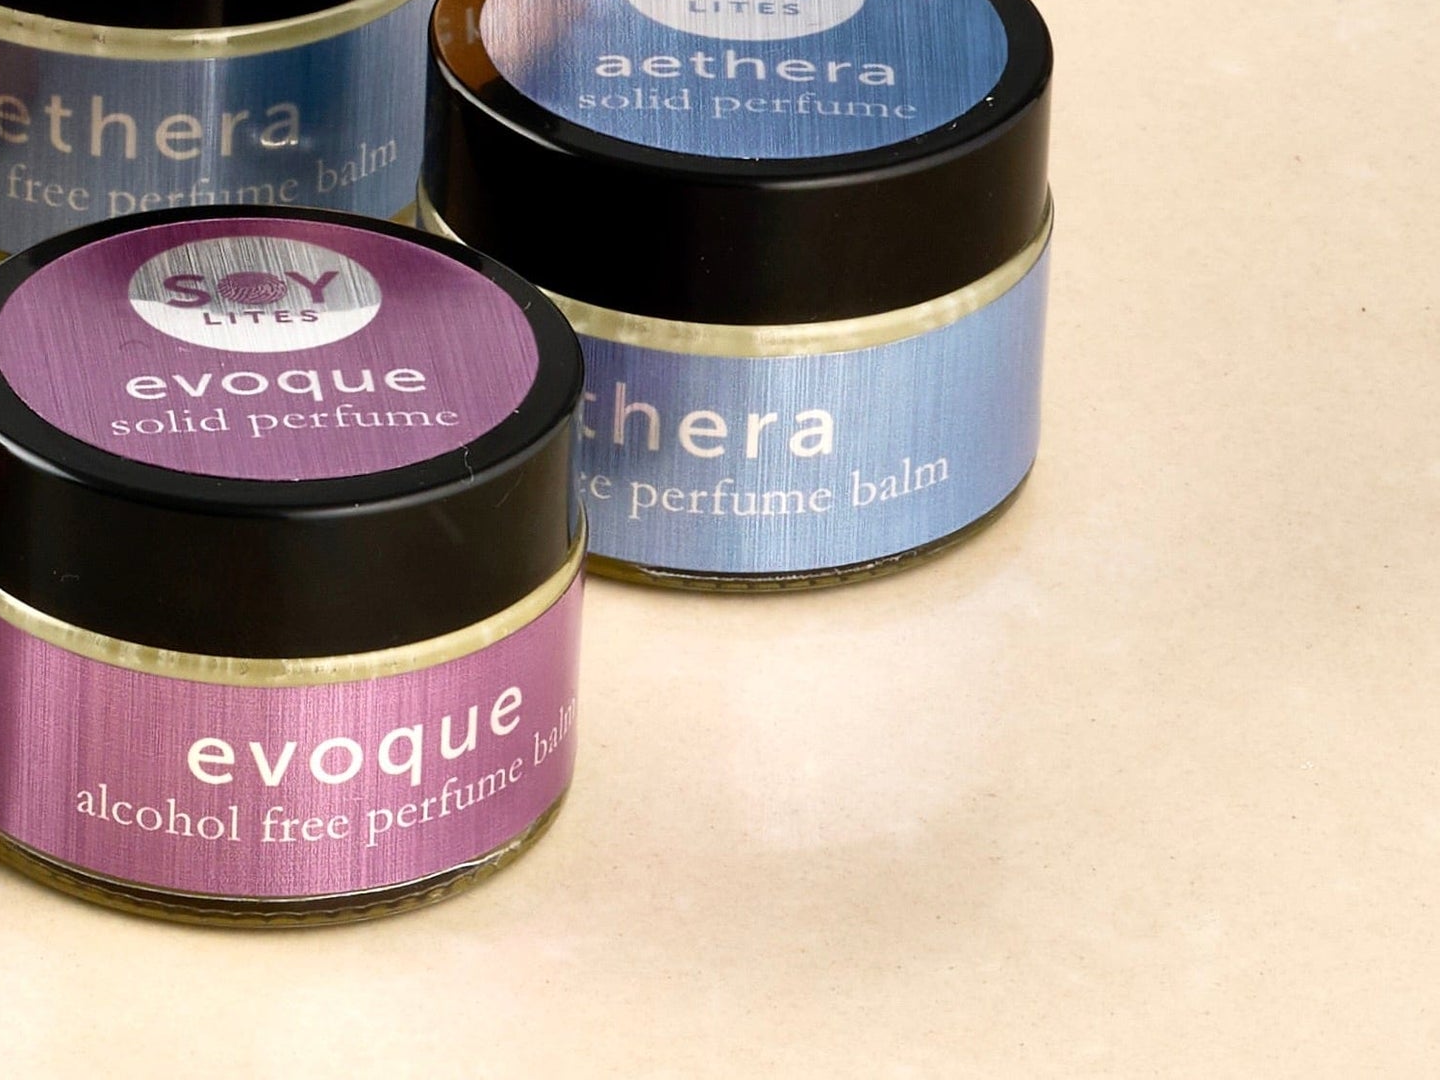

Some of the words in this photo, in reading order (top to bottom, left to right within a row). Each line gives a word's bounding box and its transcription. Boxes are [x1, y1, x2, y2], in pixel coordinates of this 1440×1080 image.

[688, 1, 801, 16] LITES
[595, 50, 897, 87] aethera
[579, 88, 691, 113] solid
[712, 91, 917, 121] perfume
[6, 166, 91, 213] free
[315, 136, 398, 194] balm
[162, 270, 339, 310] SOY
[204, 308, 320, 326] LITES
[124, 368, 427, 404] evoque
[111, 409, 228, 437] solid
[246, 403, 459, 438] perfume
[628, 474, 833, 520] perfume
[852, 453, 949, 507] balm
[186, 685, 522, 788] evoque
[76, 783, 239, 842] alcohol
[260, 804, 351, 843] free
[366, 756, 524, 849] perfume
[533, 696, 577, 767] balm
